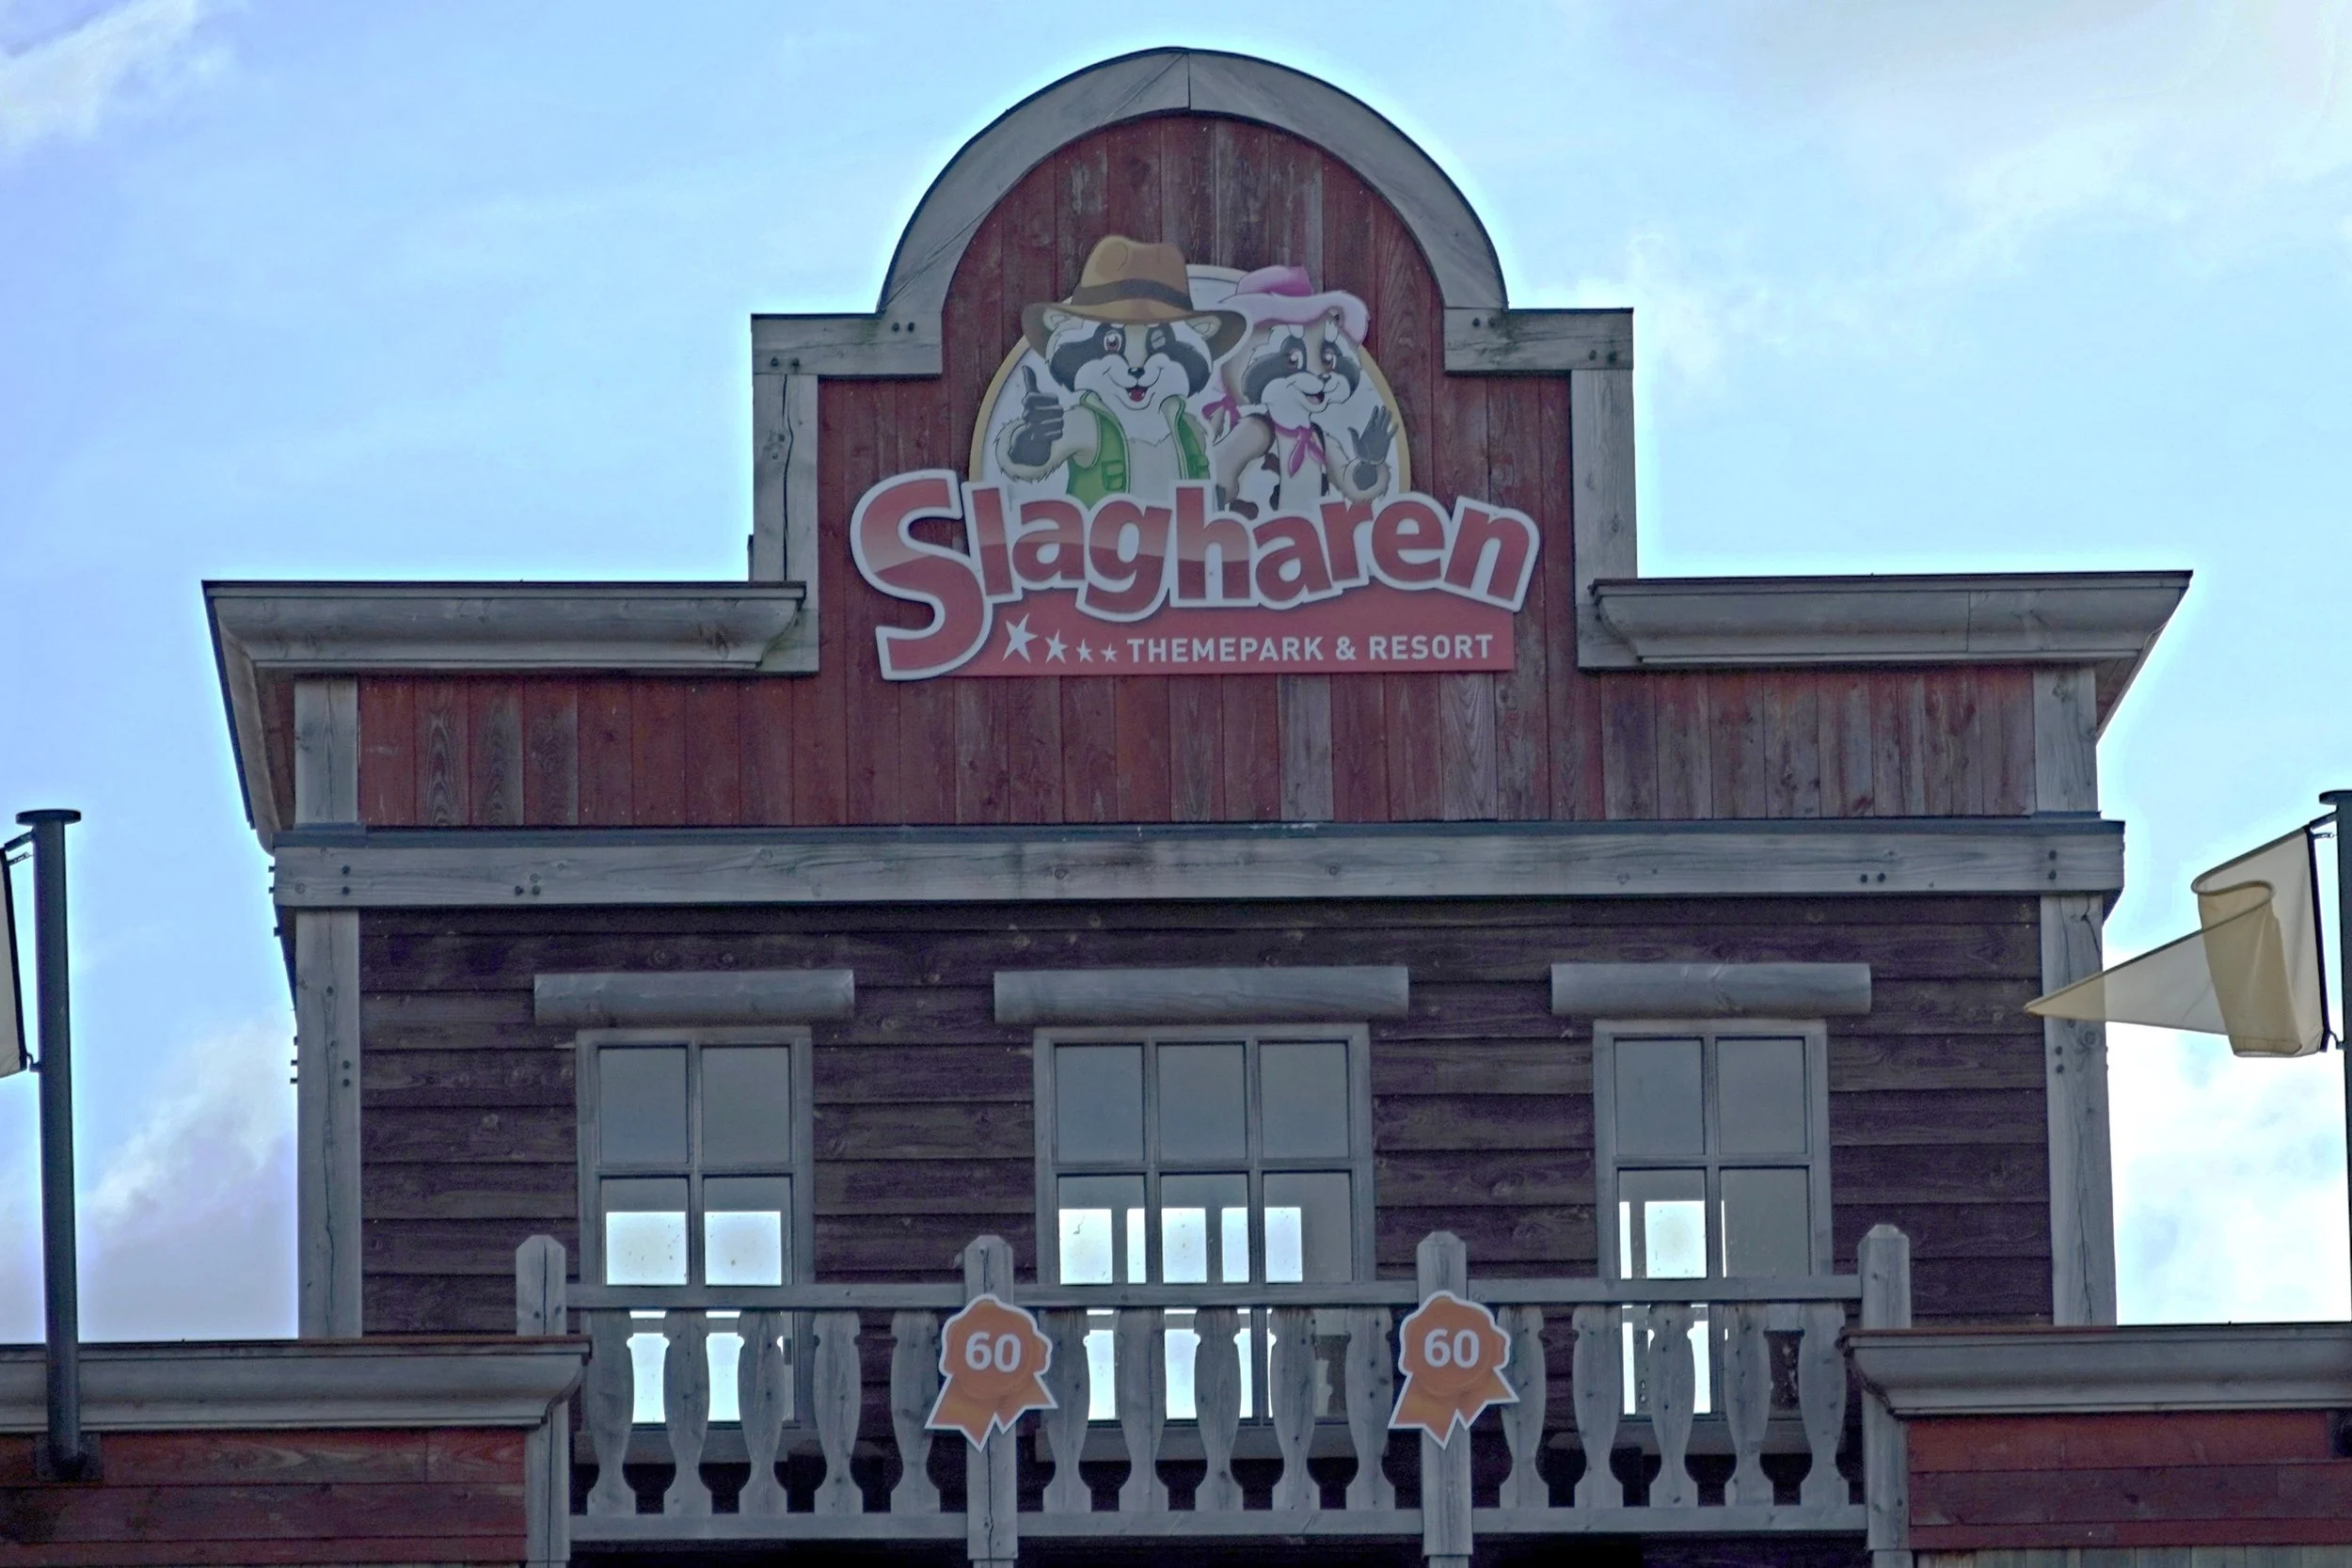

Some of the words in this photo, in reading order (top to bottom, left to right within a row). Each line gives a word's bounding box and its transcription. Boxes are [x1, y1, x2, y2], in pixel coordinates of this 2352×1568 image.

[850, 469, 1540, 680] Slagharen
[1127, 636, 1324, 663] THEMEPARK
[1336, 637, 1357, 660] &
[1369, 634, 1493, 660] RESORT
[964, 1331, 1021, 1372] 60
[1423, 1328, 1481, 1368] 60
